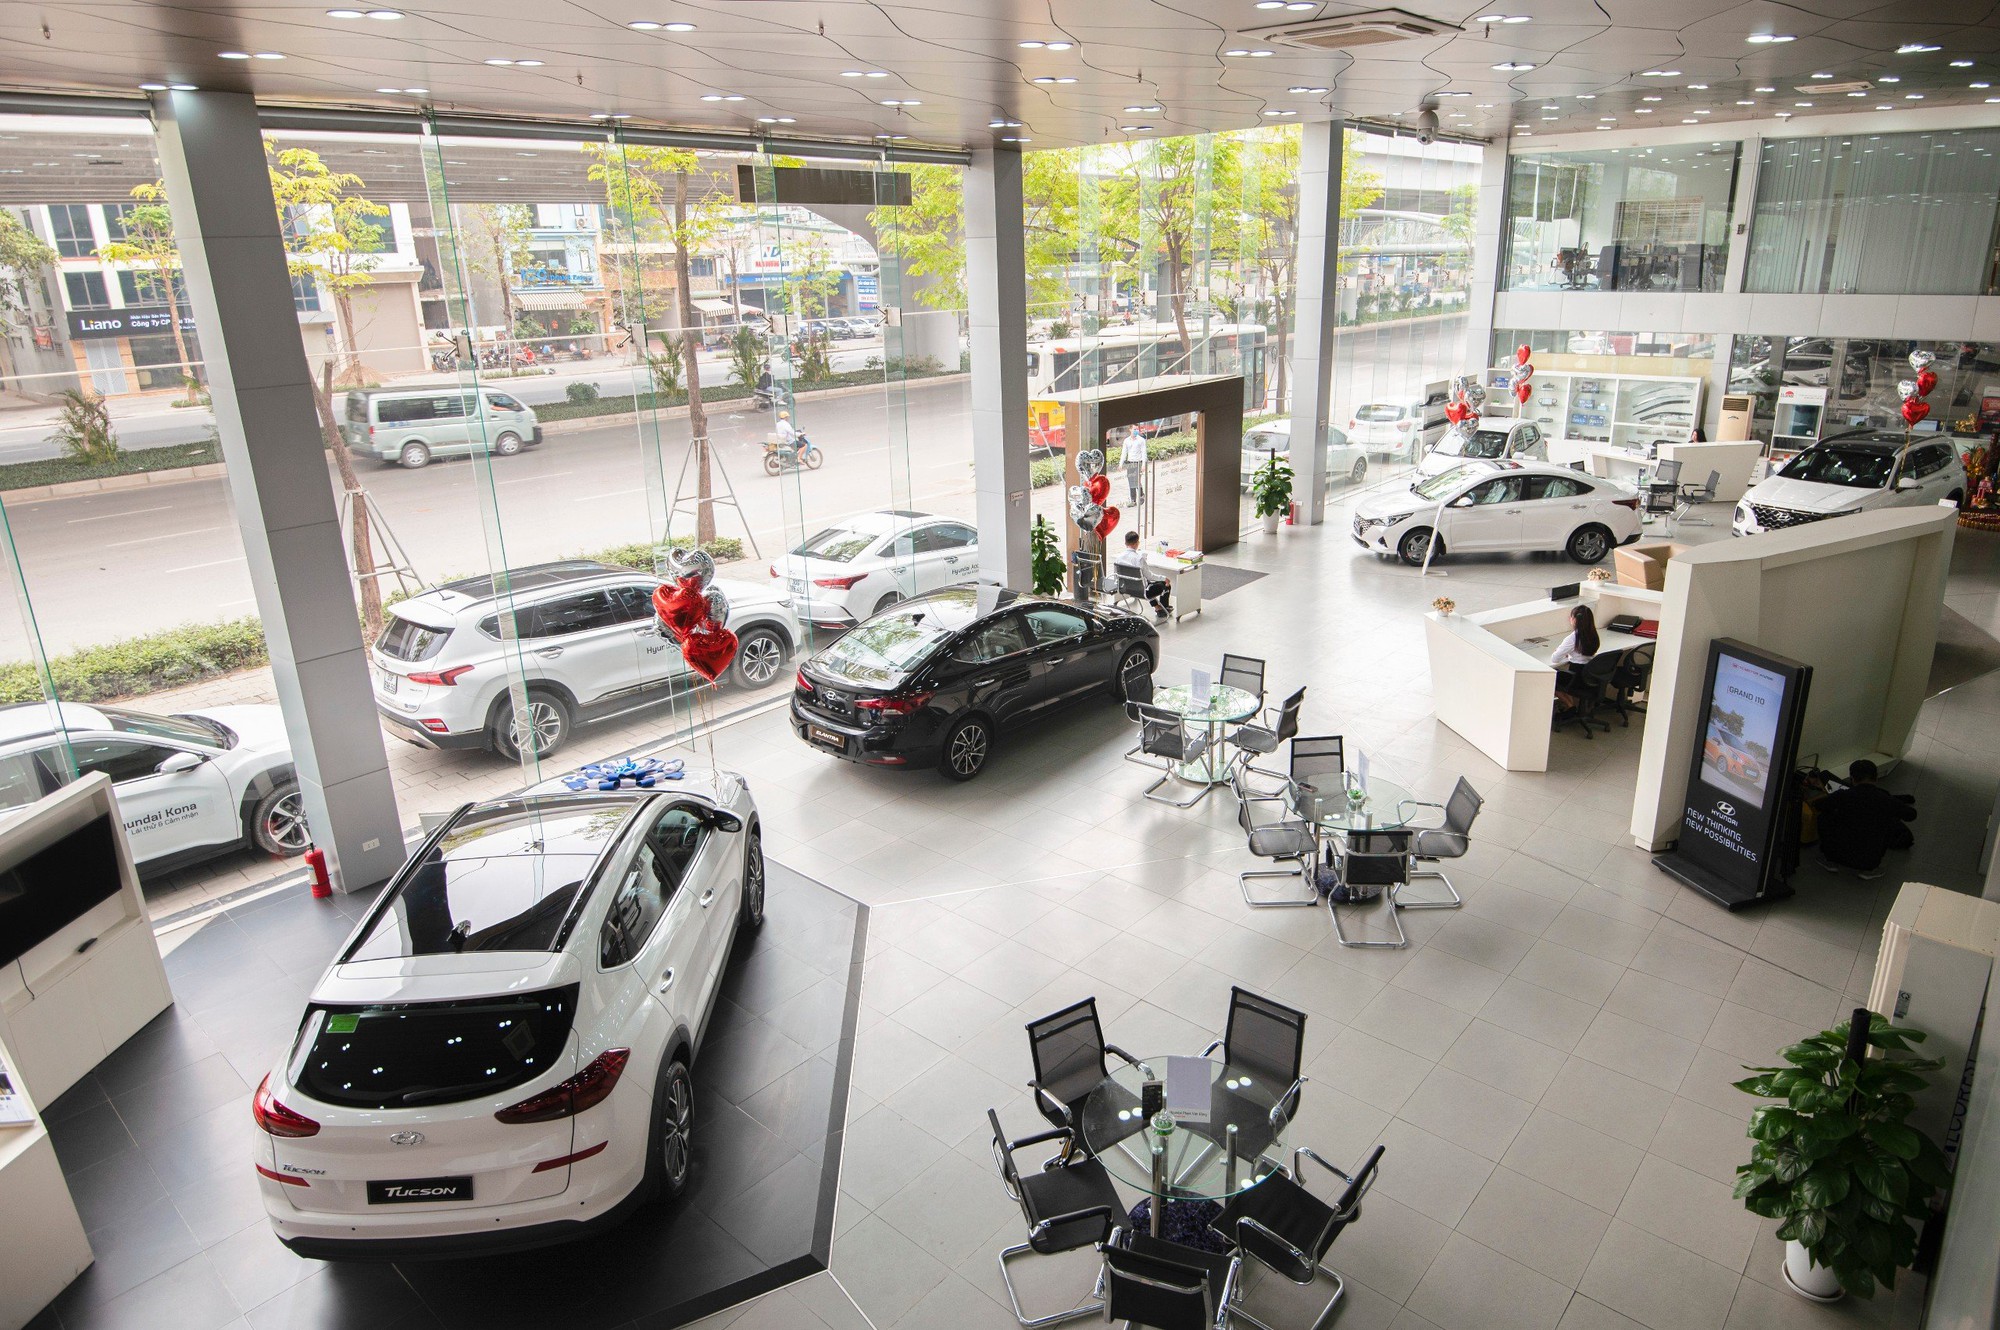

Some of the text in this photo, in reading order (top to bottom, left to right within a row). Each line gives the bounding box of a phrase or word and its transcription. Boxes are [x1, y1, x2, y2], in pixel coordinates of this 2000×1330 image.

[81, 319, 122, 331] Liano
[1729, 686, 1753, 701] GRAND
[815, 729, 840, 742] ELANTRA
[165, 803, 198, 818] Kona
[1711, 809, 1739, 827] HYUNDAI
[1687, 807, 1743, 843] NEW THINKING.
[1685, 817, 1758, 863] NEW POSSIBILITIES.
[283, 1163, 326, 1175] TUCSON
[385, 1186, 457, 1198] TUCSON
